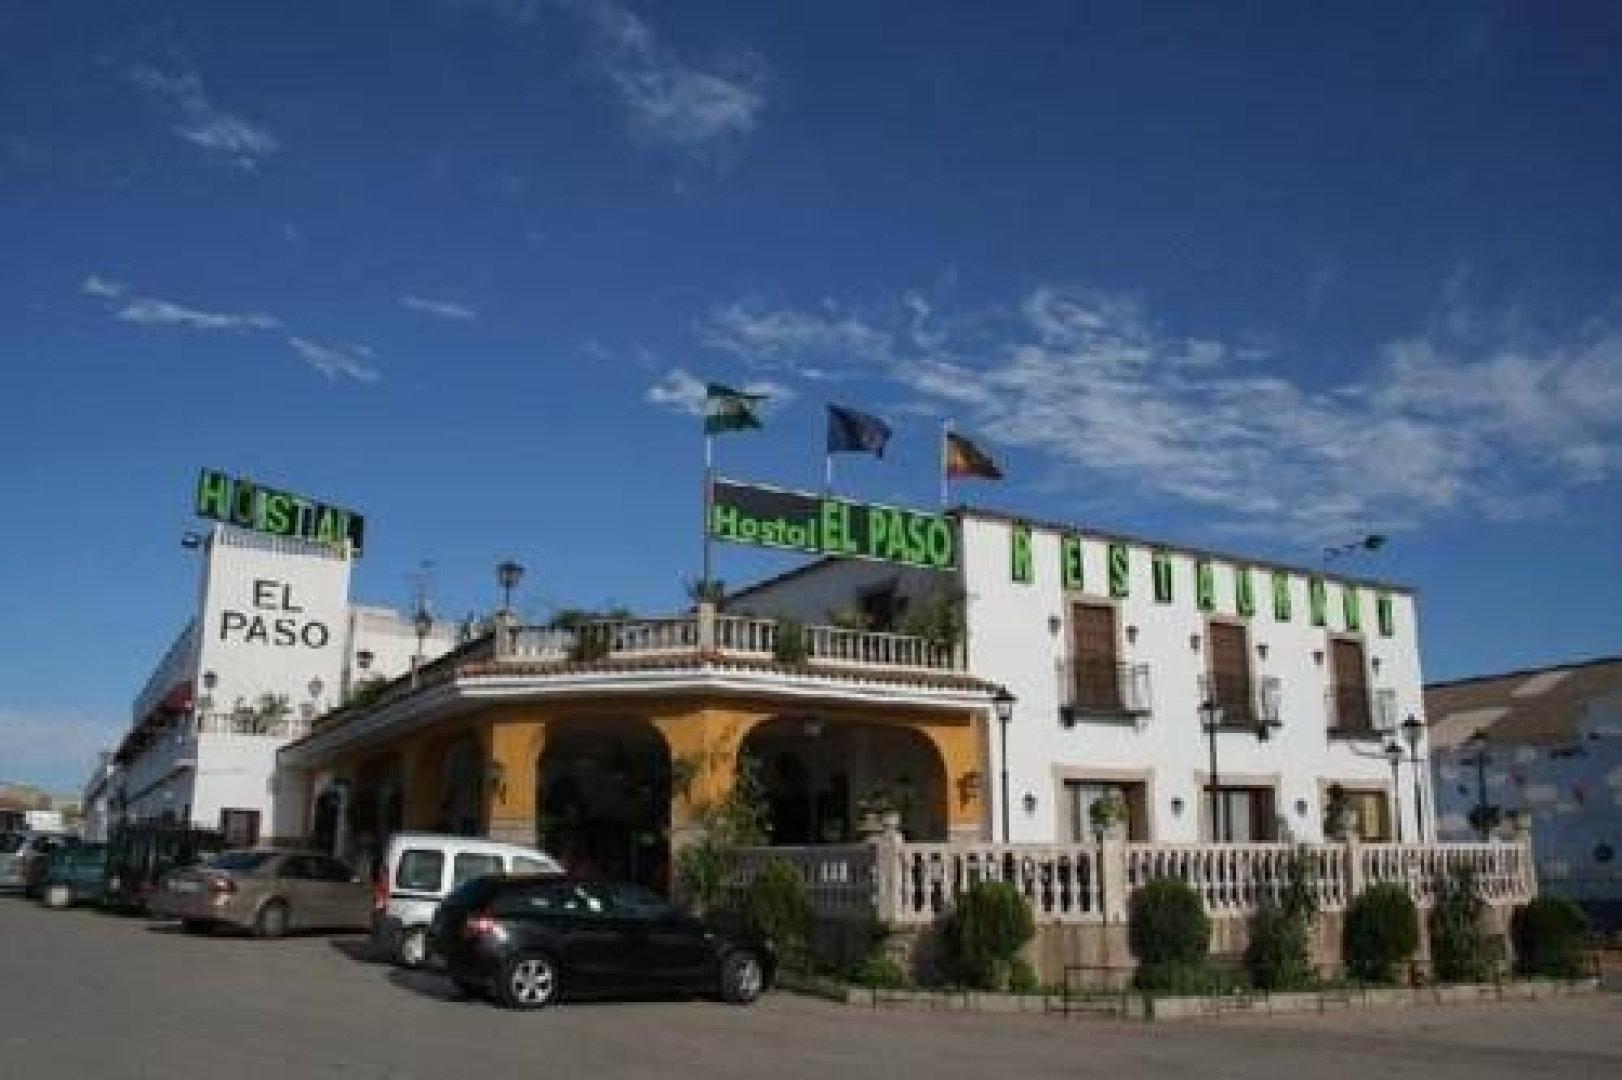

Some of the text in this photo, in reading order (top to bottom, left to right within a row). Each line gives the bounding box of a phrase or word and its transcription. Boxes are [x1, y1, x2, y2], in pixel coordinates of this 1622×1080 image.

[198, 468, 361, 555] HOSTAL
[714, 501, 952, 566] Hostal EL PASO
[253, 579, 302, 613] EL
[1011, 520, 1393, 636] RESTAURANT
[220, 611, 329, 649] PASO
